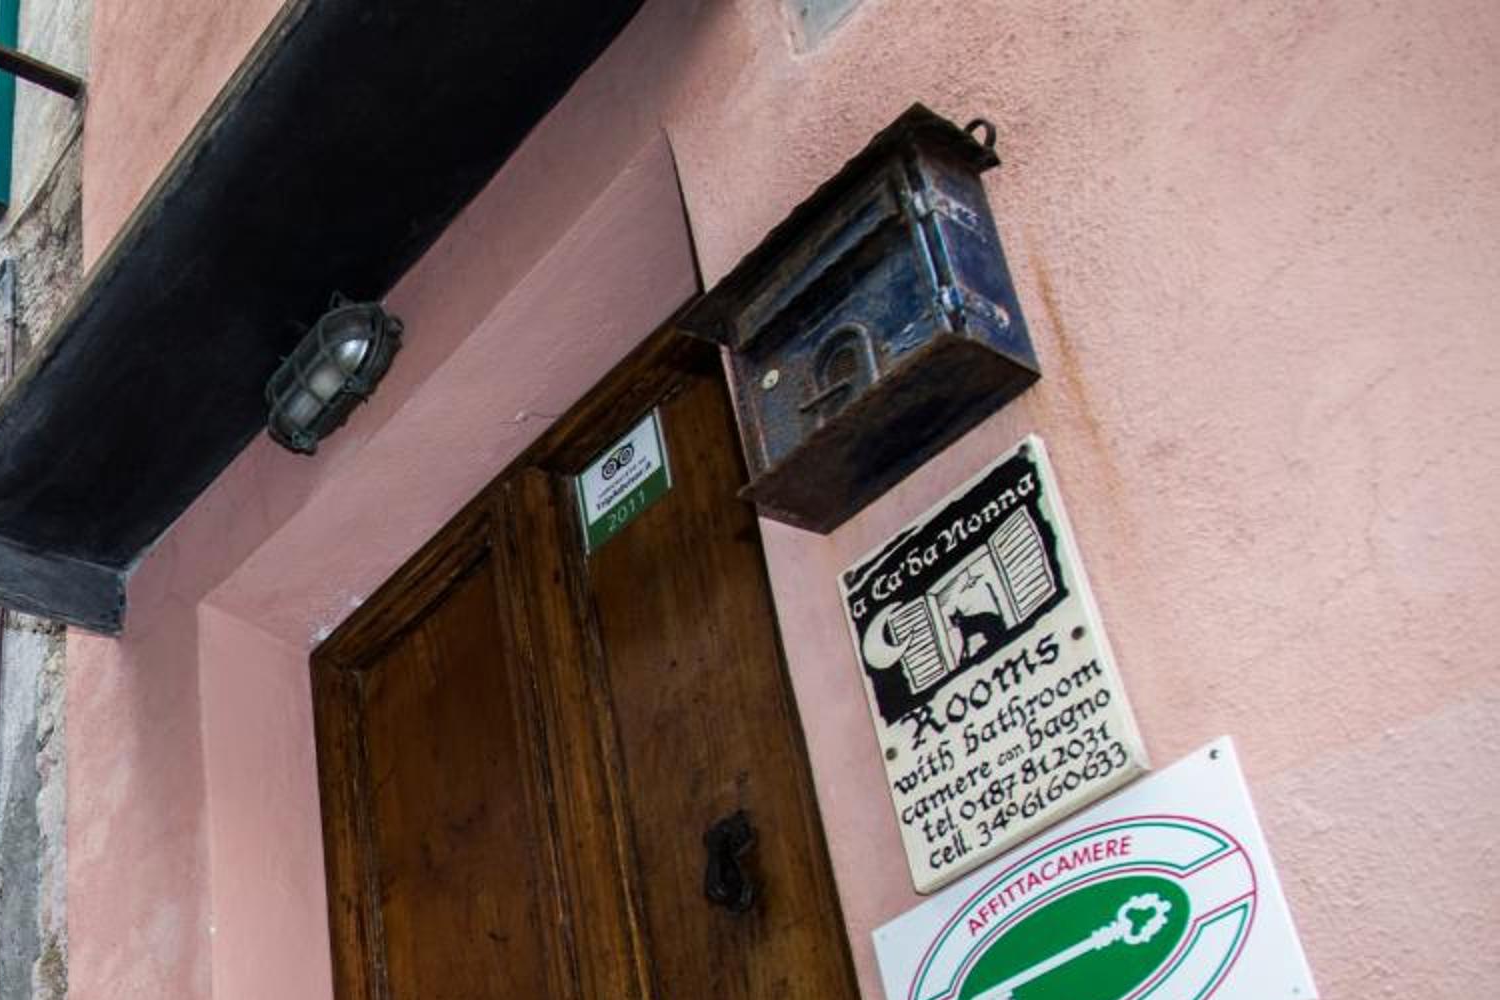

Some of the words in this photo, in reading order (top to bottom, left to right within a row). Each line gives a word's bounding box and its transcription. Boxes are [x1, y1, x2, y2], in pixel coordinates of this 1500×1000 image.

[852, 598, 868, 618] a
[894, 740, 955, 795] with
[962, 659, 1102, 756] bathroom
[902, 760, 992, 825] camere
[996, 743, 1025, 767] con
[1026, 689, 1111, 750] bagno
[960, 773, 1018, 821] 0187
[1021, 720, 1112, 785] 812031
[966, 836, 1133, 936] AFFITTACAMERE
